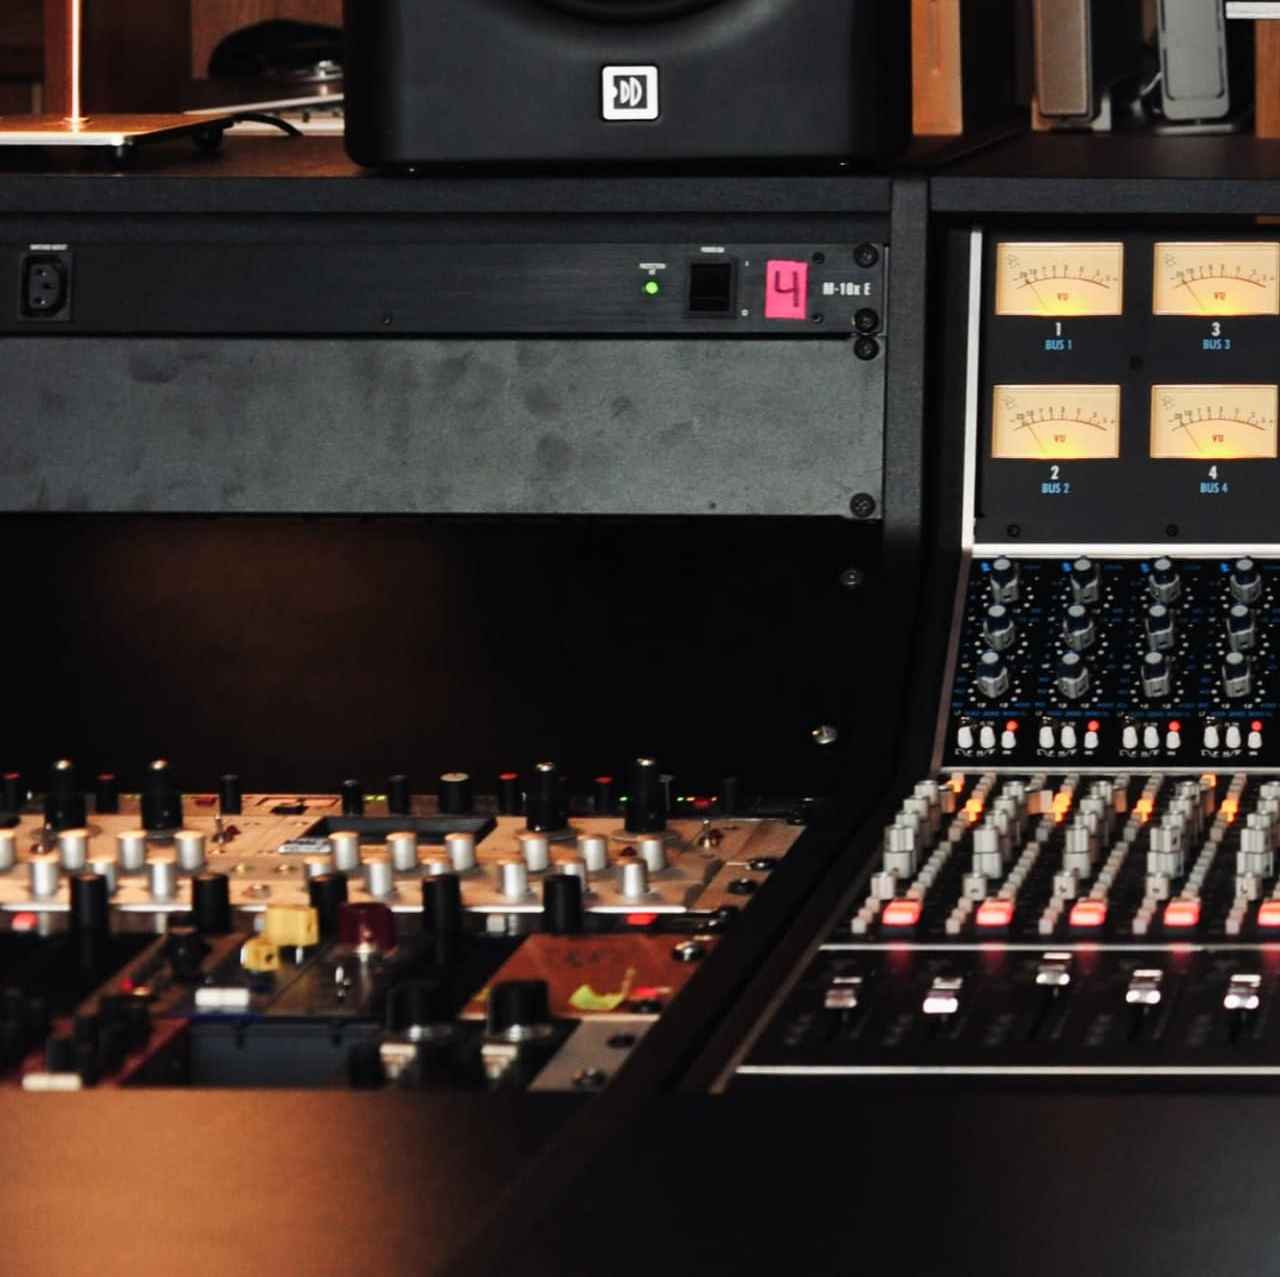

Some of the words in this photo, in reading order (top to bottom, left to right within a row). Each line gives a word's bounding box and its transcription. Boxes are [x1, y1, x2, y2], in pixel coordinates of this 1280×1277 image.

[775, 270, 799, 308] 4
[864, 283, 870, 295] E
[1056, 322, 1061, 336] 1
[1212, 322, 1220, 336] 3
[1045, 339, 1065, 351] BUS
[1067, 339, 1072, 350] 1
[1202, 338, 1223, 350] BUS
[1224, 338, 1231, 350] 3
[1051, 466, 1059, 479] 2
[1209, 466, 1217, 479] 4
[1041, 482, 1062, 494] BUS
[1200, 482, 1220, 494] BUS
